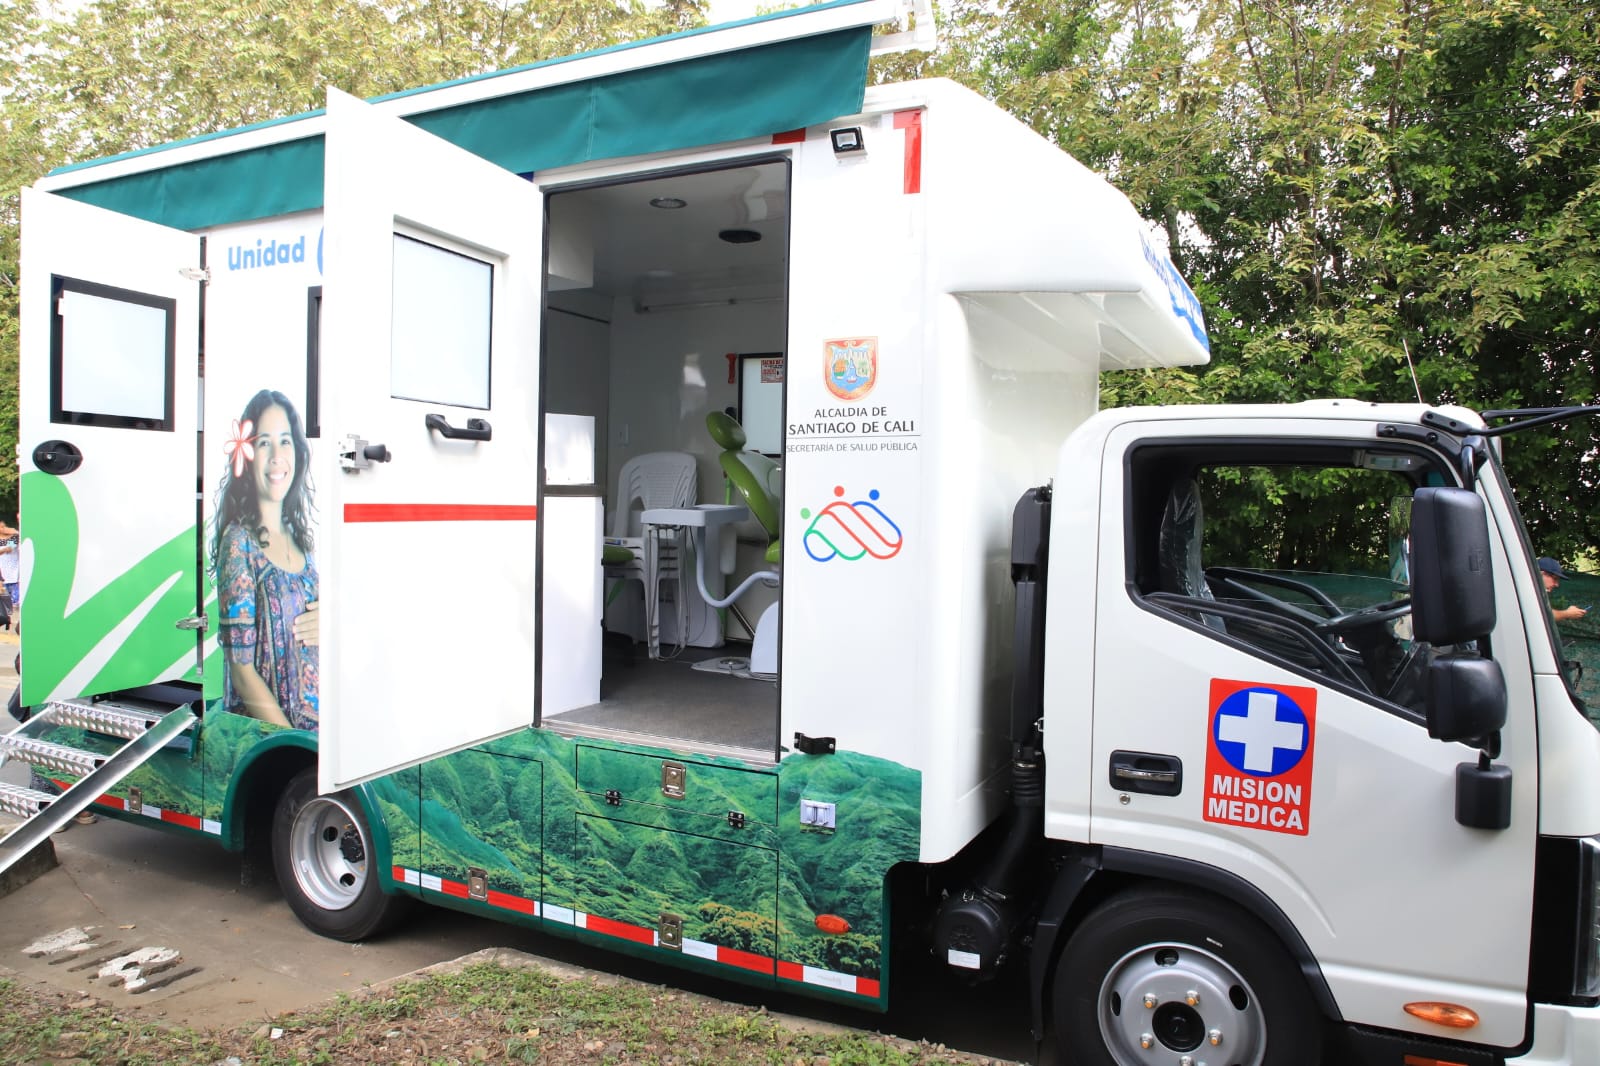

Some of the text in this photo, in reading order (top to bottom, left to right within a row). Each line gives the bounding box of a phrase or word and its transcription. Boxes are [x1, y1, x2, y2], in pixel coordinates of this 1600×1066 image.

[228, 235, 305, 271] Unidad
[814, 406, 887, 418] ALCALDIA DE
[788, 420, 914, 435] SANTIAGO DE CALI
[836, 443, 848, 452] DE
[850, 443, 878, 452] SALUD
[1213, 775, 1301, 805] MISION
[1208, 798, 1303, 830] MEDICA
